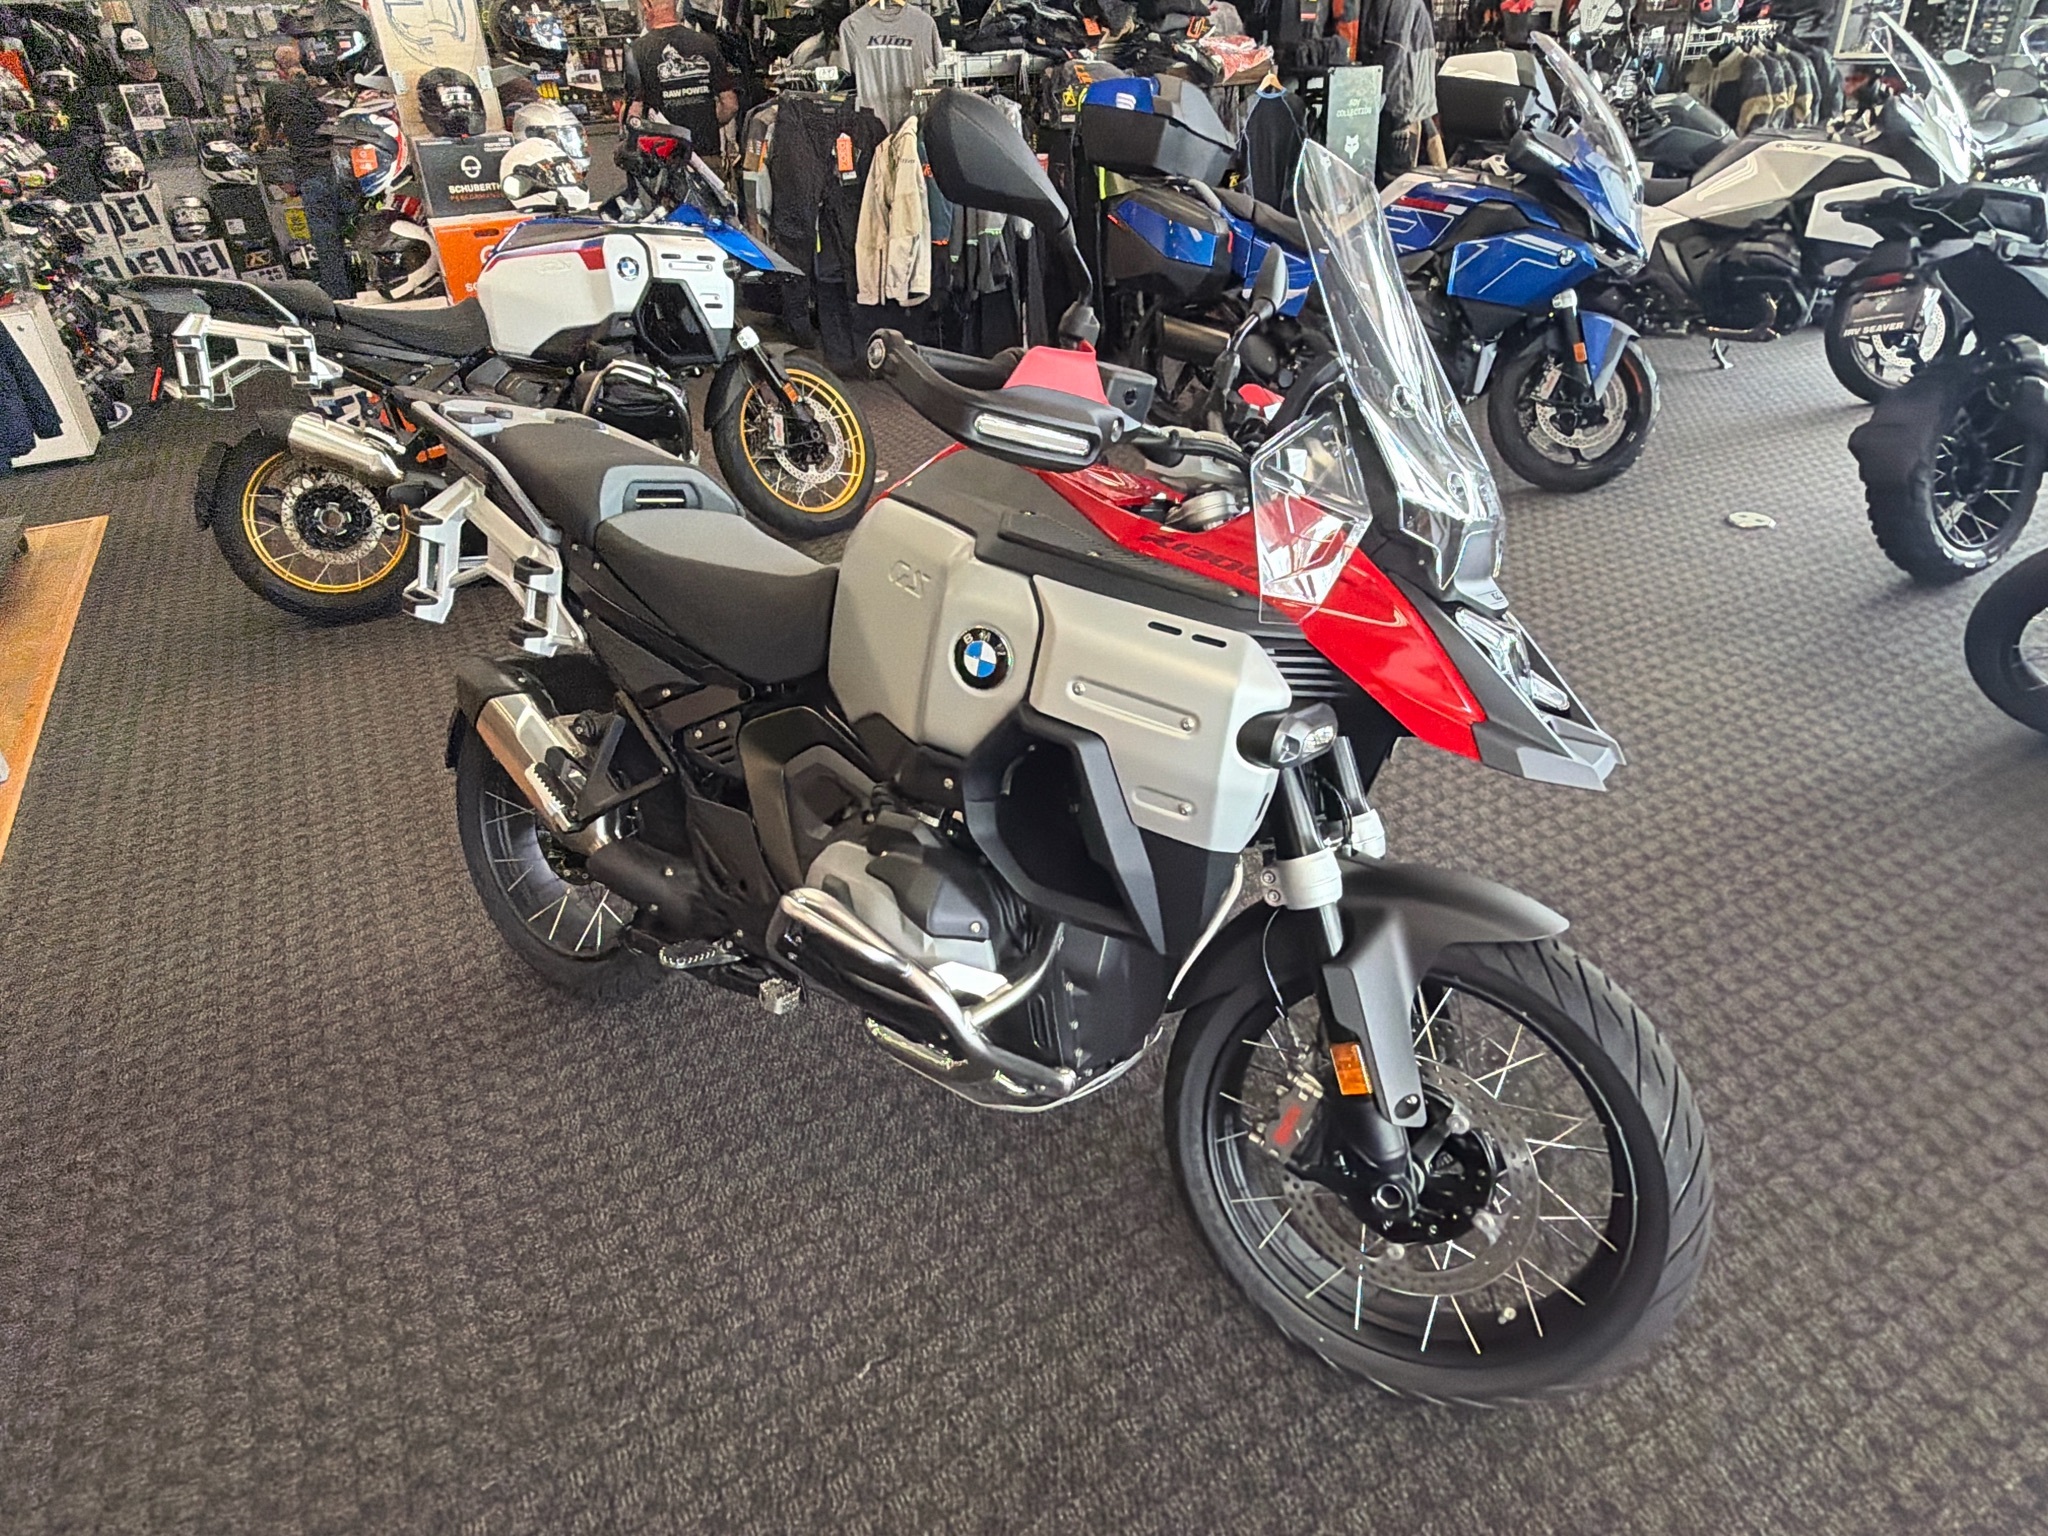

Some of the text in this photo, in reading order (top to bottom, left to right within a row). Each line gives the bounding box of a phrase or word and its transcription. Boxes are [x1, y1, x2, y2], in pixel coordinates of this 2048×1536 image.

[662, 86, 710, 99] RAW POWER
[1843, 321, 1905, 337] IRV SEAVER
[963, 629, 1006, 657] BMW
